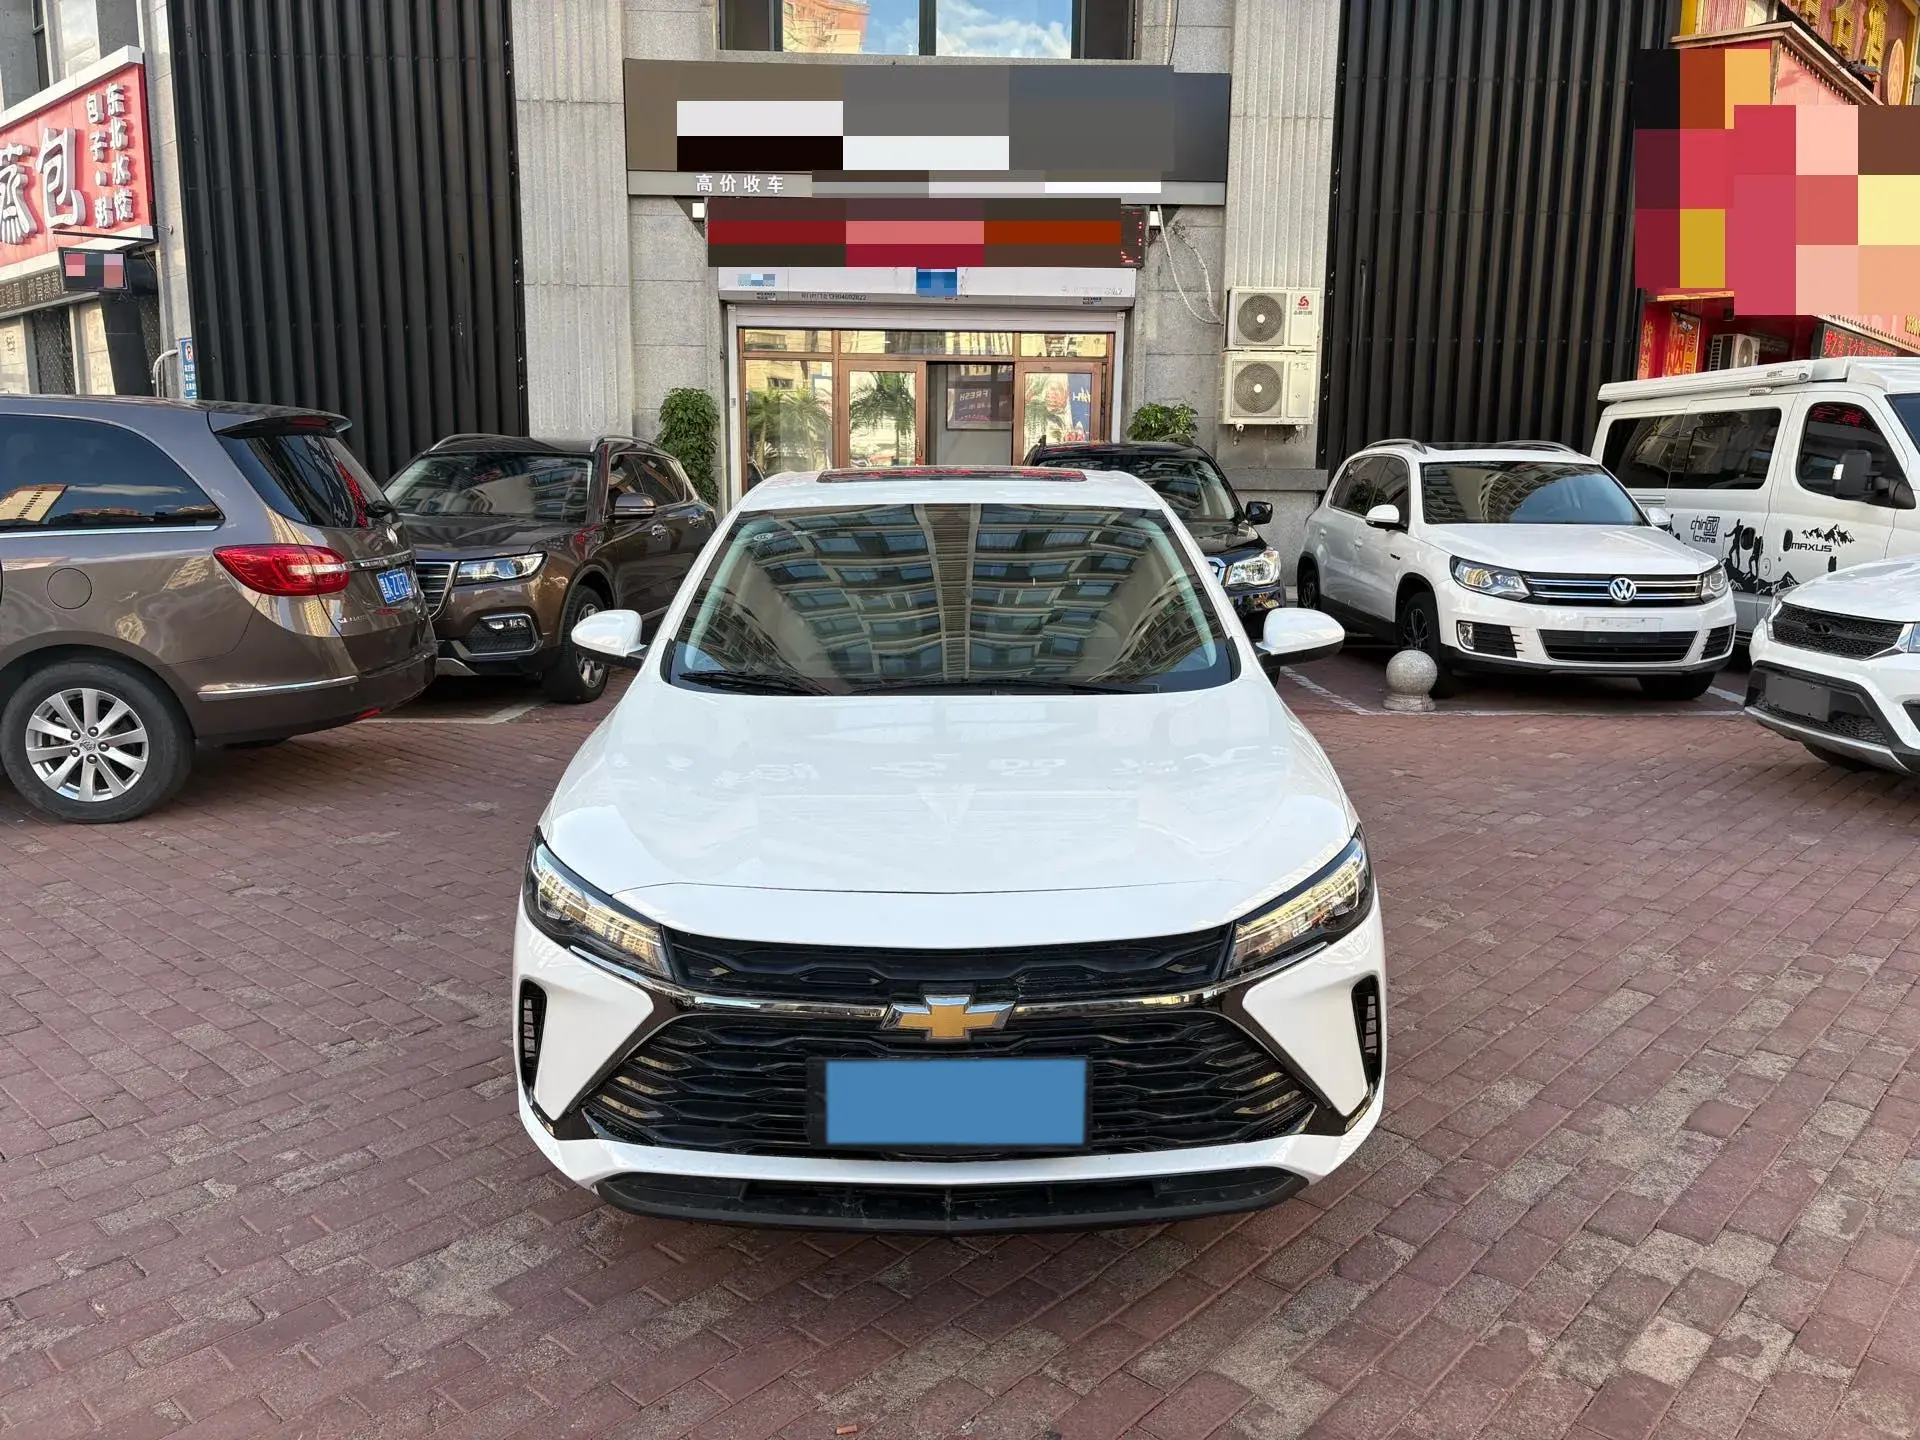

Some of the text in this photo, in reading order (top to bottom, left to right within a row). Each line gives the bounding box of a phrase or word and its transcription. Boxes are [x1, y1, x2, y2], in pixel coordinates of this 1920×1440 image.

[695, 174, 784, 193] 高价收车
[1791, 542, 1832, 552] MAXUS
